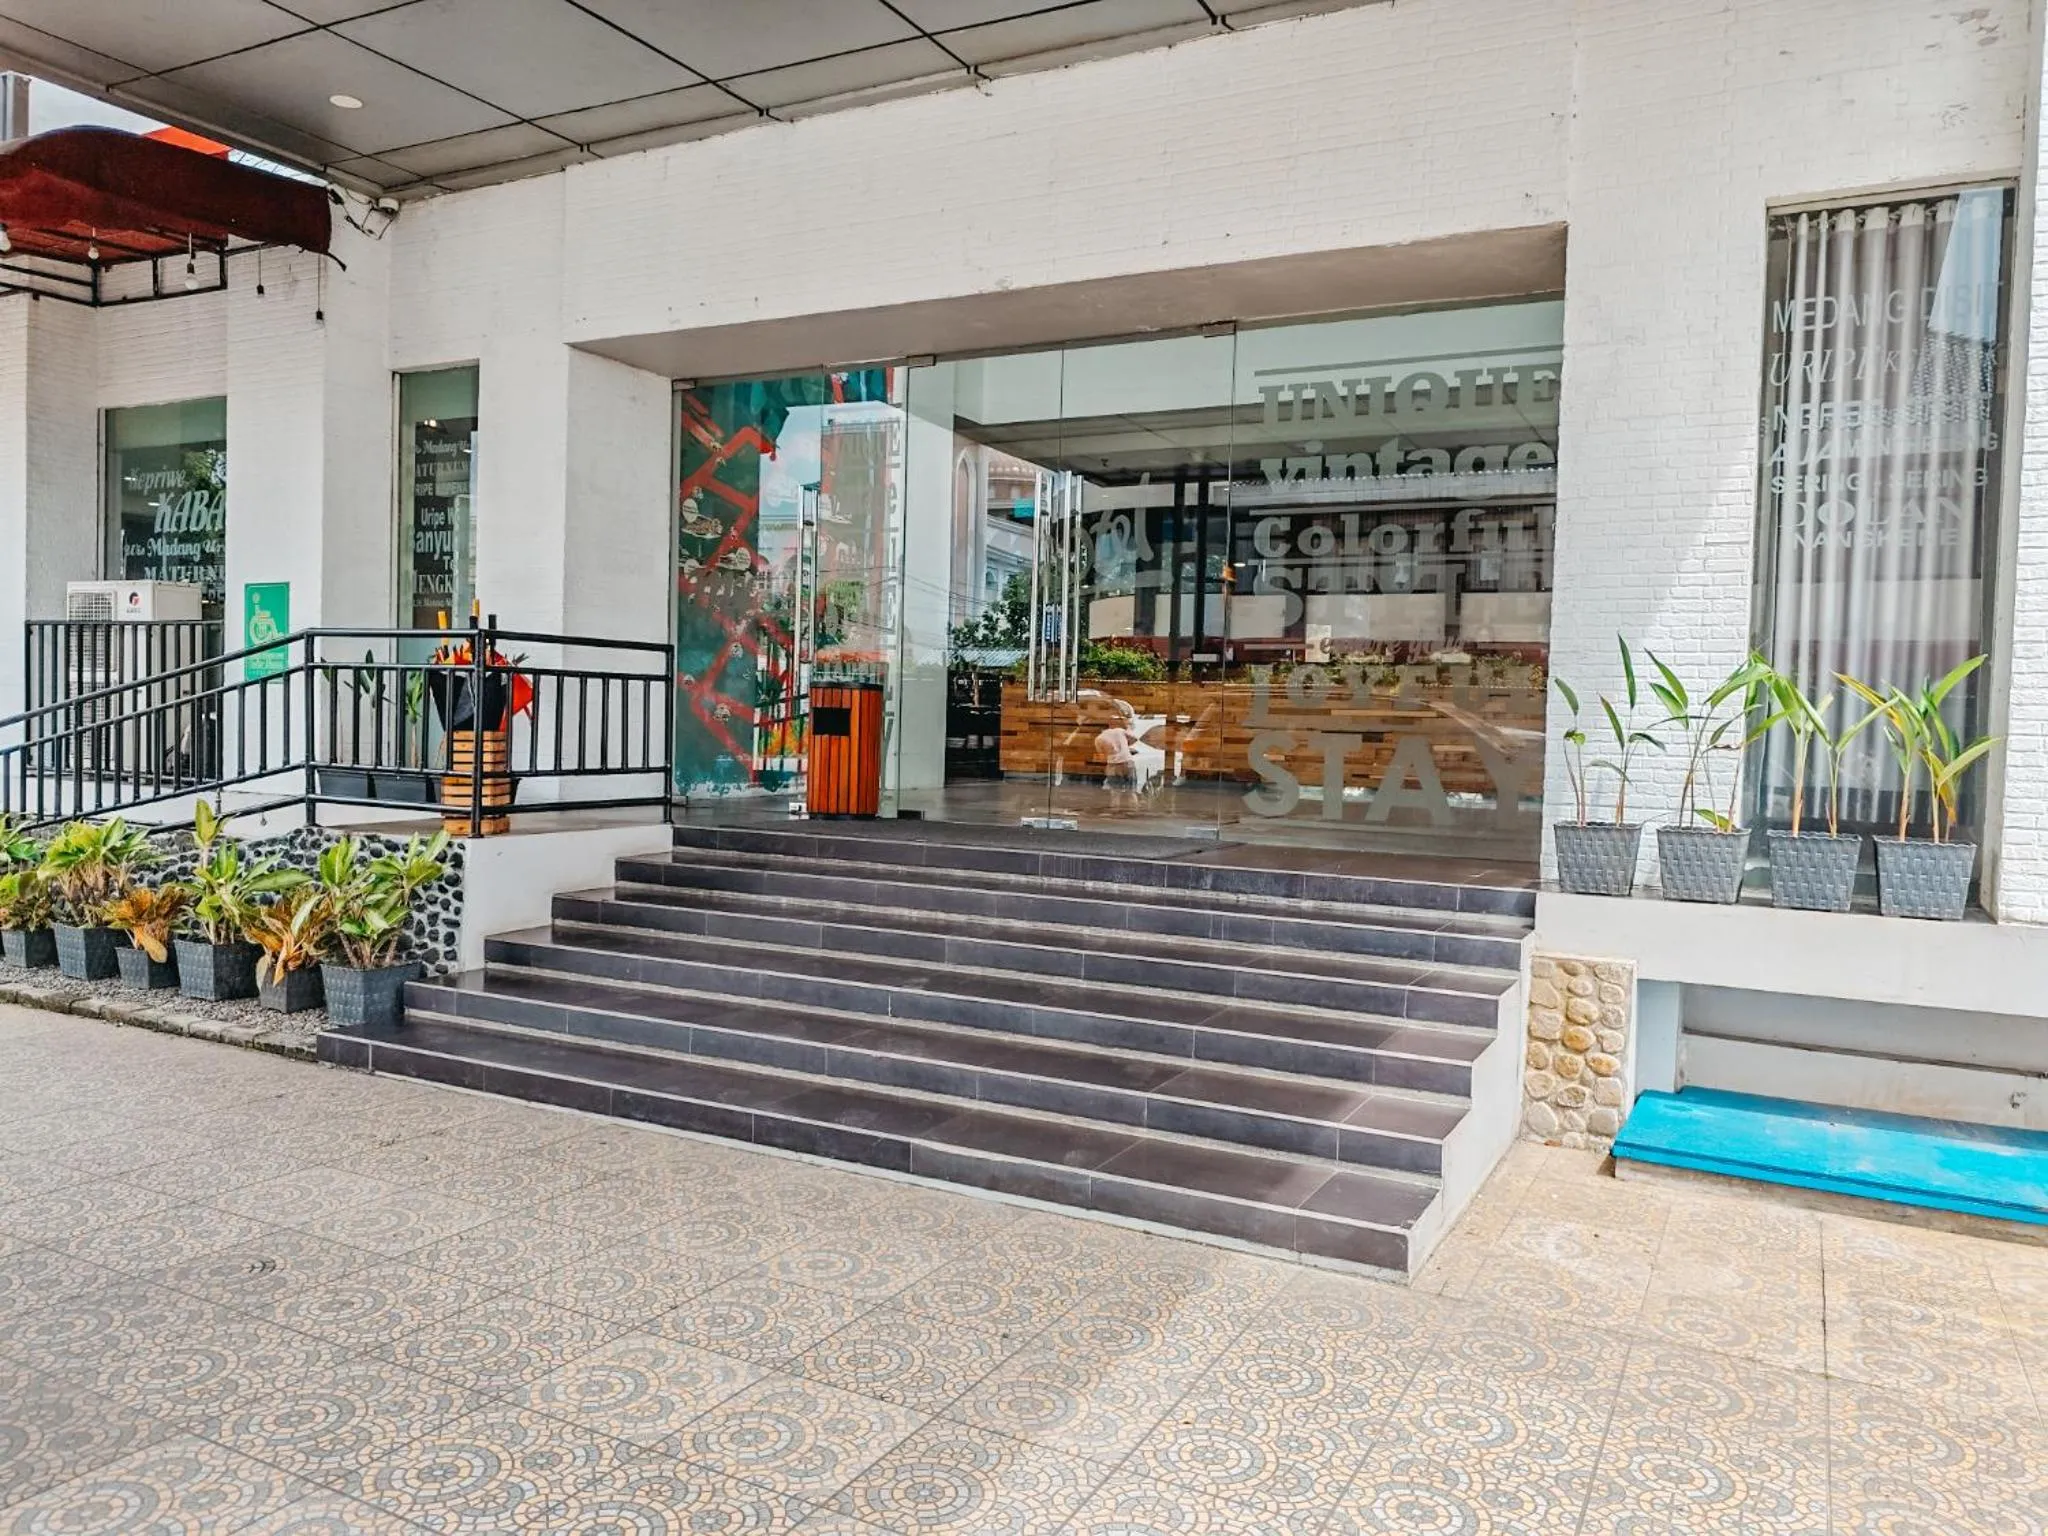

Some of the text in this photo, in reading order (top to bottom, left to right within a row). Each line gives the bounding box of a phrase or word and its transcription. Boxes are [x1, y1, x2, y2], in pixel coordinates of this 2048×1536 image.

[1257, 363, 1559, 430] UNIQUE
[1259, 437, 1556, 500] vintage
[421, 507, 446, 530] Uripe
[1253, 504, 1555, 558] Colorful
[1242, 731, 1546, 827] STAY
